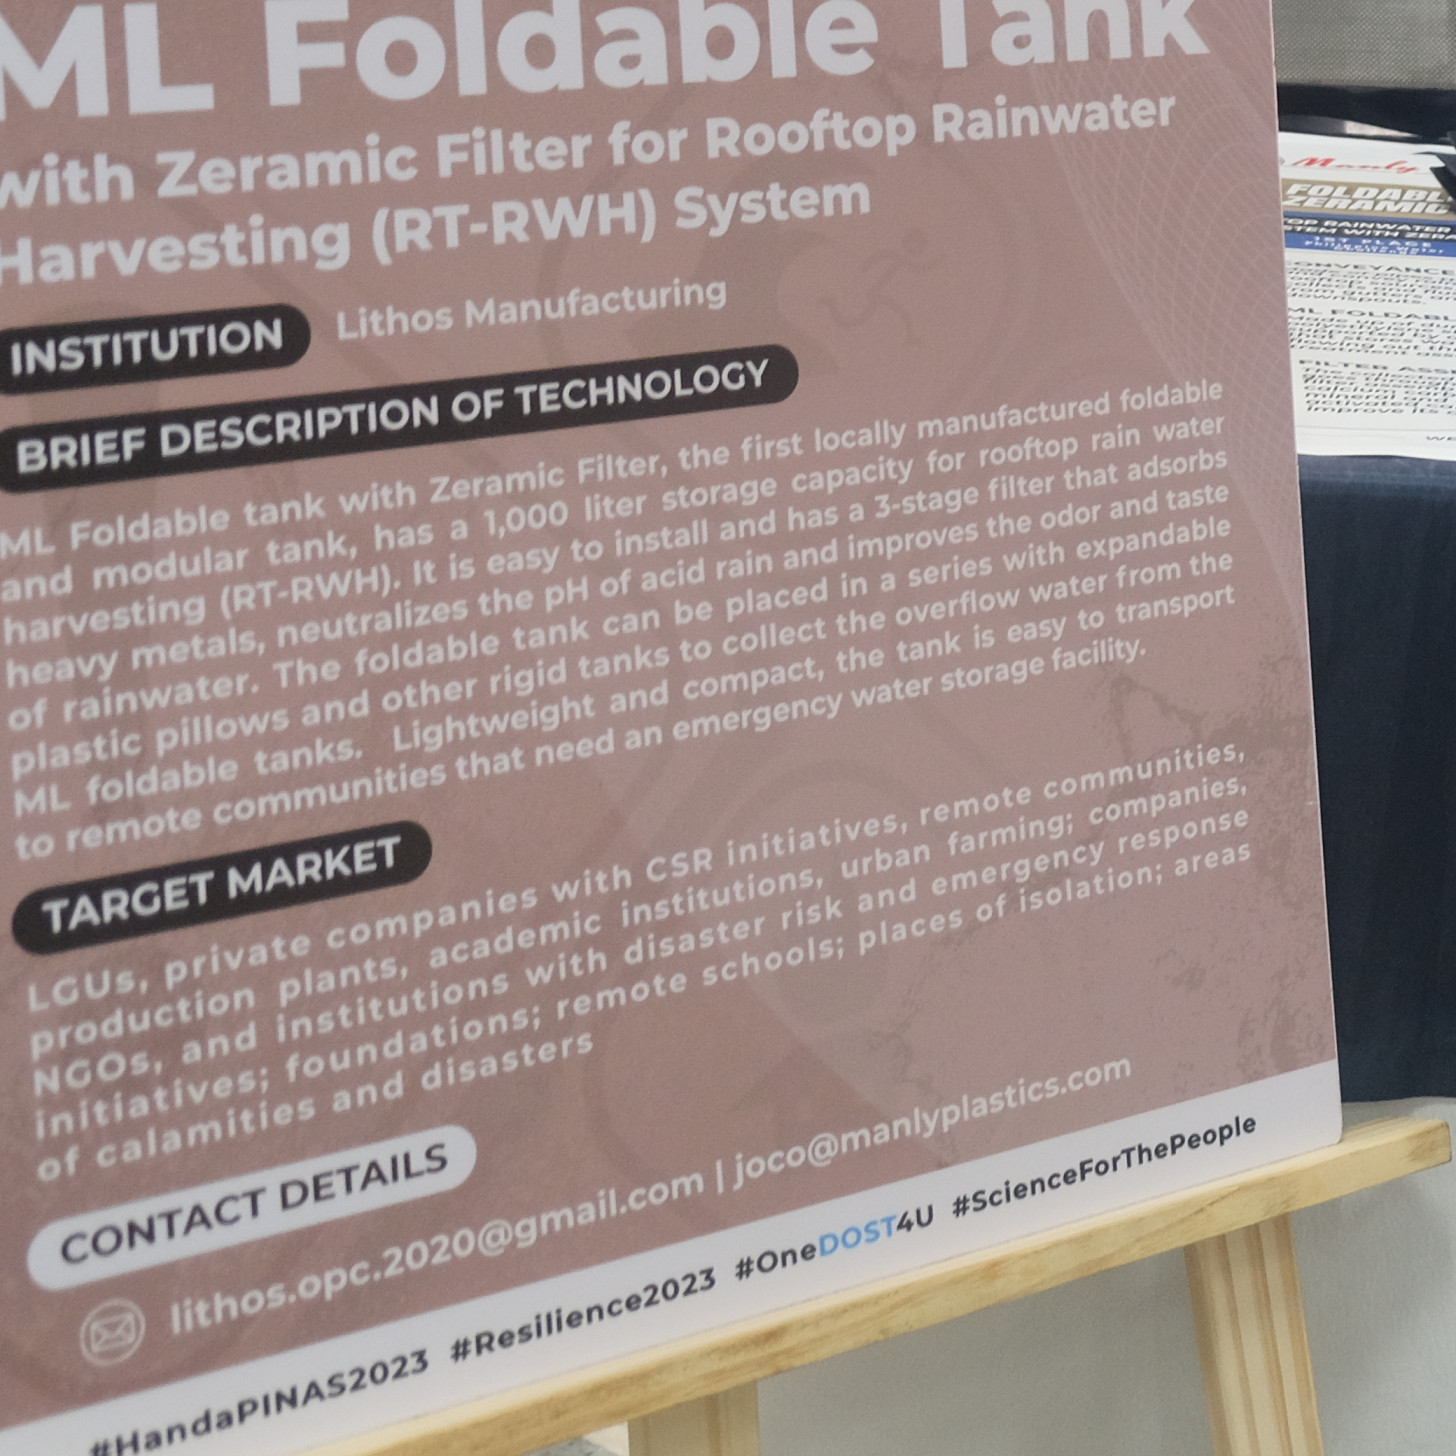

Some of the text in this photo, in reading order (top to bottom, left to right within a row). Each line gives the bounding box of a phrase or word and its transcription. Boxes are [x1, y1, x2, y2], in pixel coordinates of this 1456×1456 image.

[0, 2, 214, 122] ML
[0, 95, 1176, 208] with Zeramic Filter for Rooftop Rainwater
[1283, 196, 1451, 215] ZERAMIC
[1286, 184, 1452, 202] FOLDABL
[0, 180, 870, 287] Harvesting (RT-RWH) System
[11, 318, 283, 377] INSTITUTION
[336, 277, 727, 343] Lithos Manufacturing
[0, 379, 1223, 559] ML Foldable tank with Zeramic Filter, the first locally manufactured foldable
[16, 359, 770, 475] BRIEF DESCRIPTION OF TECHNOLOGY
[43, 836, 402, 936] TARGET MARKET
[60, 1141, 448, 1266] CONTACT DETAILS
[169, 1172, 704, 1337] lithos.opc.2020@gmail.com
[732, 1054, 1133, 1190] joco@manlyplastics.com
[89, 1112, 1257, 1456] #HandaPINAS2023 #Resilience2023 #OneDOST4U #ScienceForThePeople
